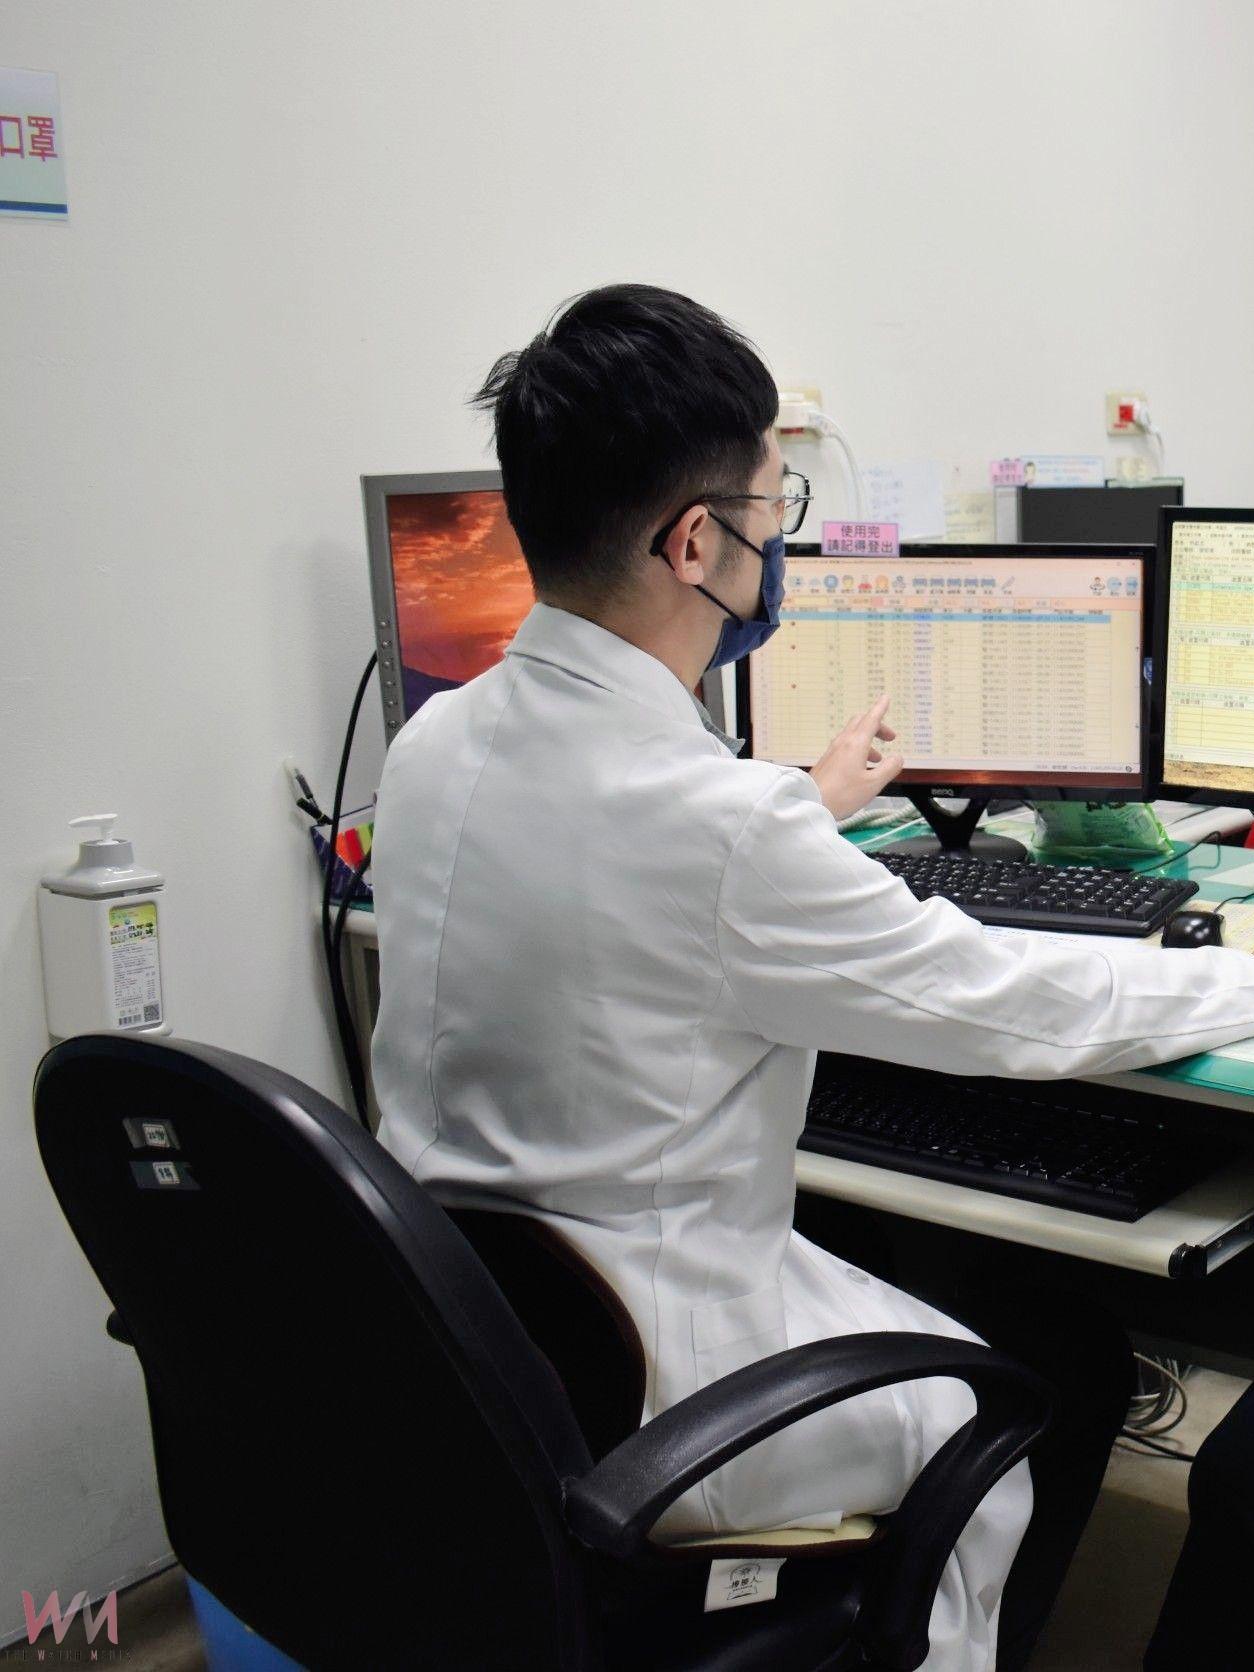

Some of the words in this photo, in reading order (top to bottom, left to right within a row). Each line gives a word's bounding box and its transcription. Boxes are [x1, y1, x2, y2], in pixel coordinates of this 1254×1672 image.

[0, 116, 58, 161] 口罩
[841, 525, 880, 539] 使用完
[827, 539, 894, 554] 請記得登出
